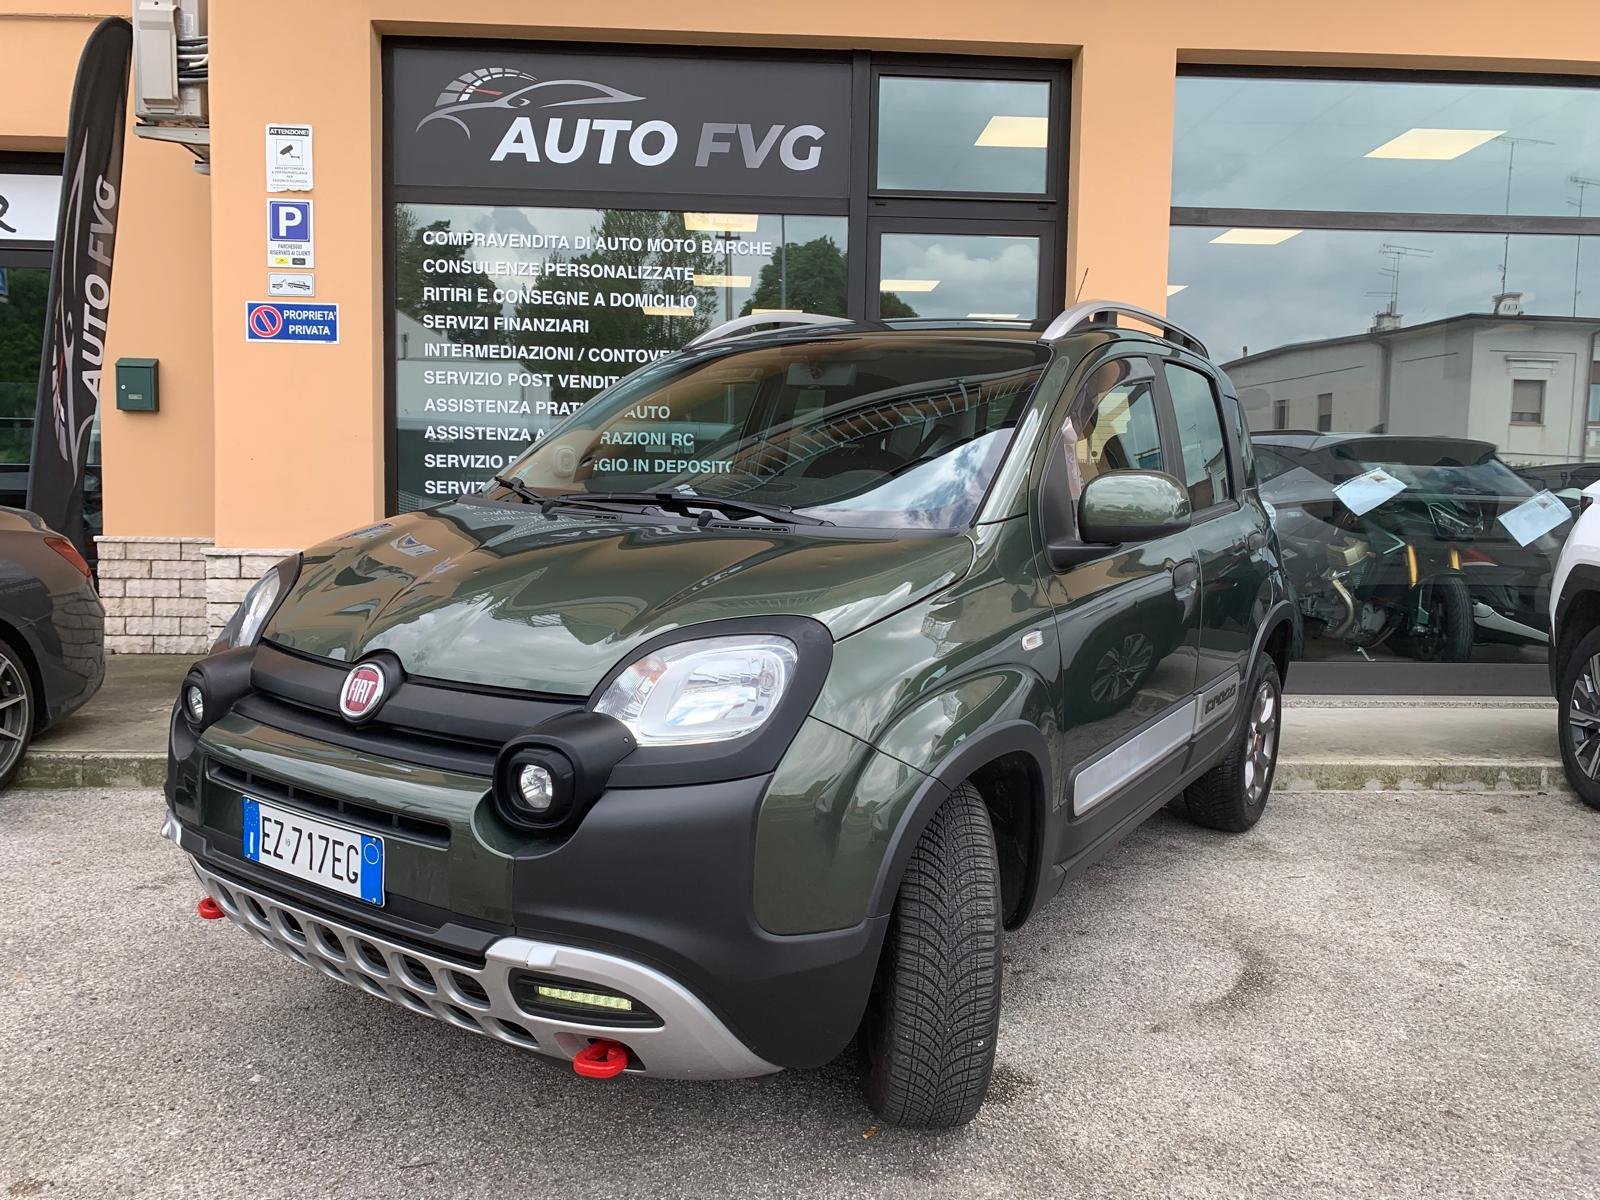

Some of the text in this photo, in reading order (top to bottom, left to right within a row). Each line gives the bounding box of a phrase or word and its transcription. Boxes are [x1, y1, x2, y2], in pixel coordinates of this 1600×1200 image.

[490, 116, 826, 171] AUTO FVG
[278, 206, 302, 237] P
[422, 231, 772, 256] COMPRAVENDITA DI AUTO MOTO BARCHE
[422, 259, 694, 281] CONSULENZE PERSONALIZZATE
[82, 174, 116, 402] AUTO FVG
[423, 287, 697, 309] RITIRI E CONSEGNE A DOMICILIO
[288, 325, 331, 335] PRIVATA
[422, 315, 589, 333] SERVIZI FINANZIARI
[424, 343, 574, 361] INTERMEDIAZIONI
[578, 348, 585, 361] /
[424, 370, 625, 389] SERVIZIO POST VENDIT
[424, 398, 531, 414] ASSISTENZA
[536, 401, 584, 415] PRAT
[424, 426, 532, 441] ASSISTENZA
[671, 432, 694, 446] RC
[424, 454, 503, 469] SERVIZIO
[633, 459, 649, 472] IN
[347, 678, 376, 704] FIAT
